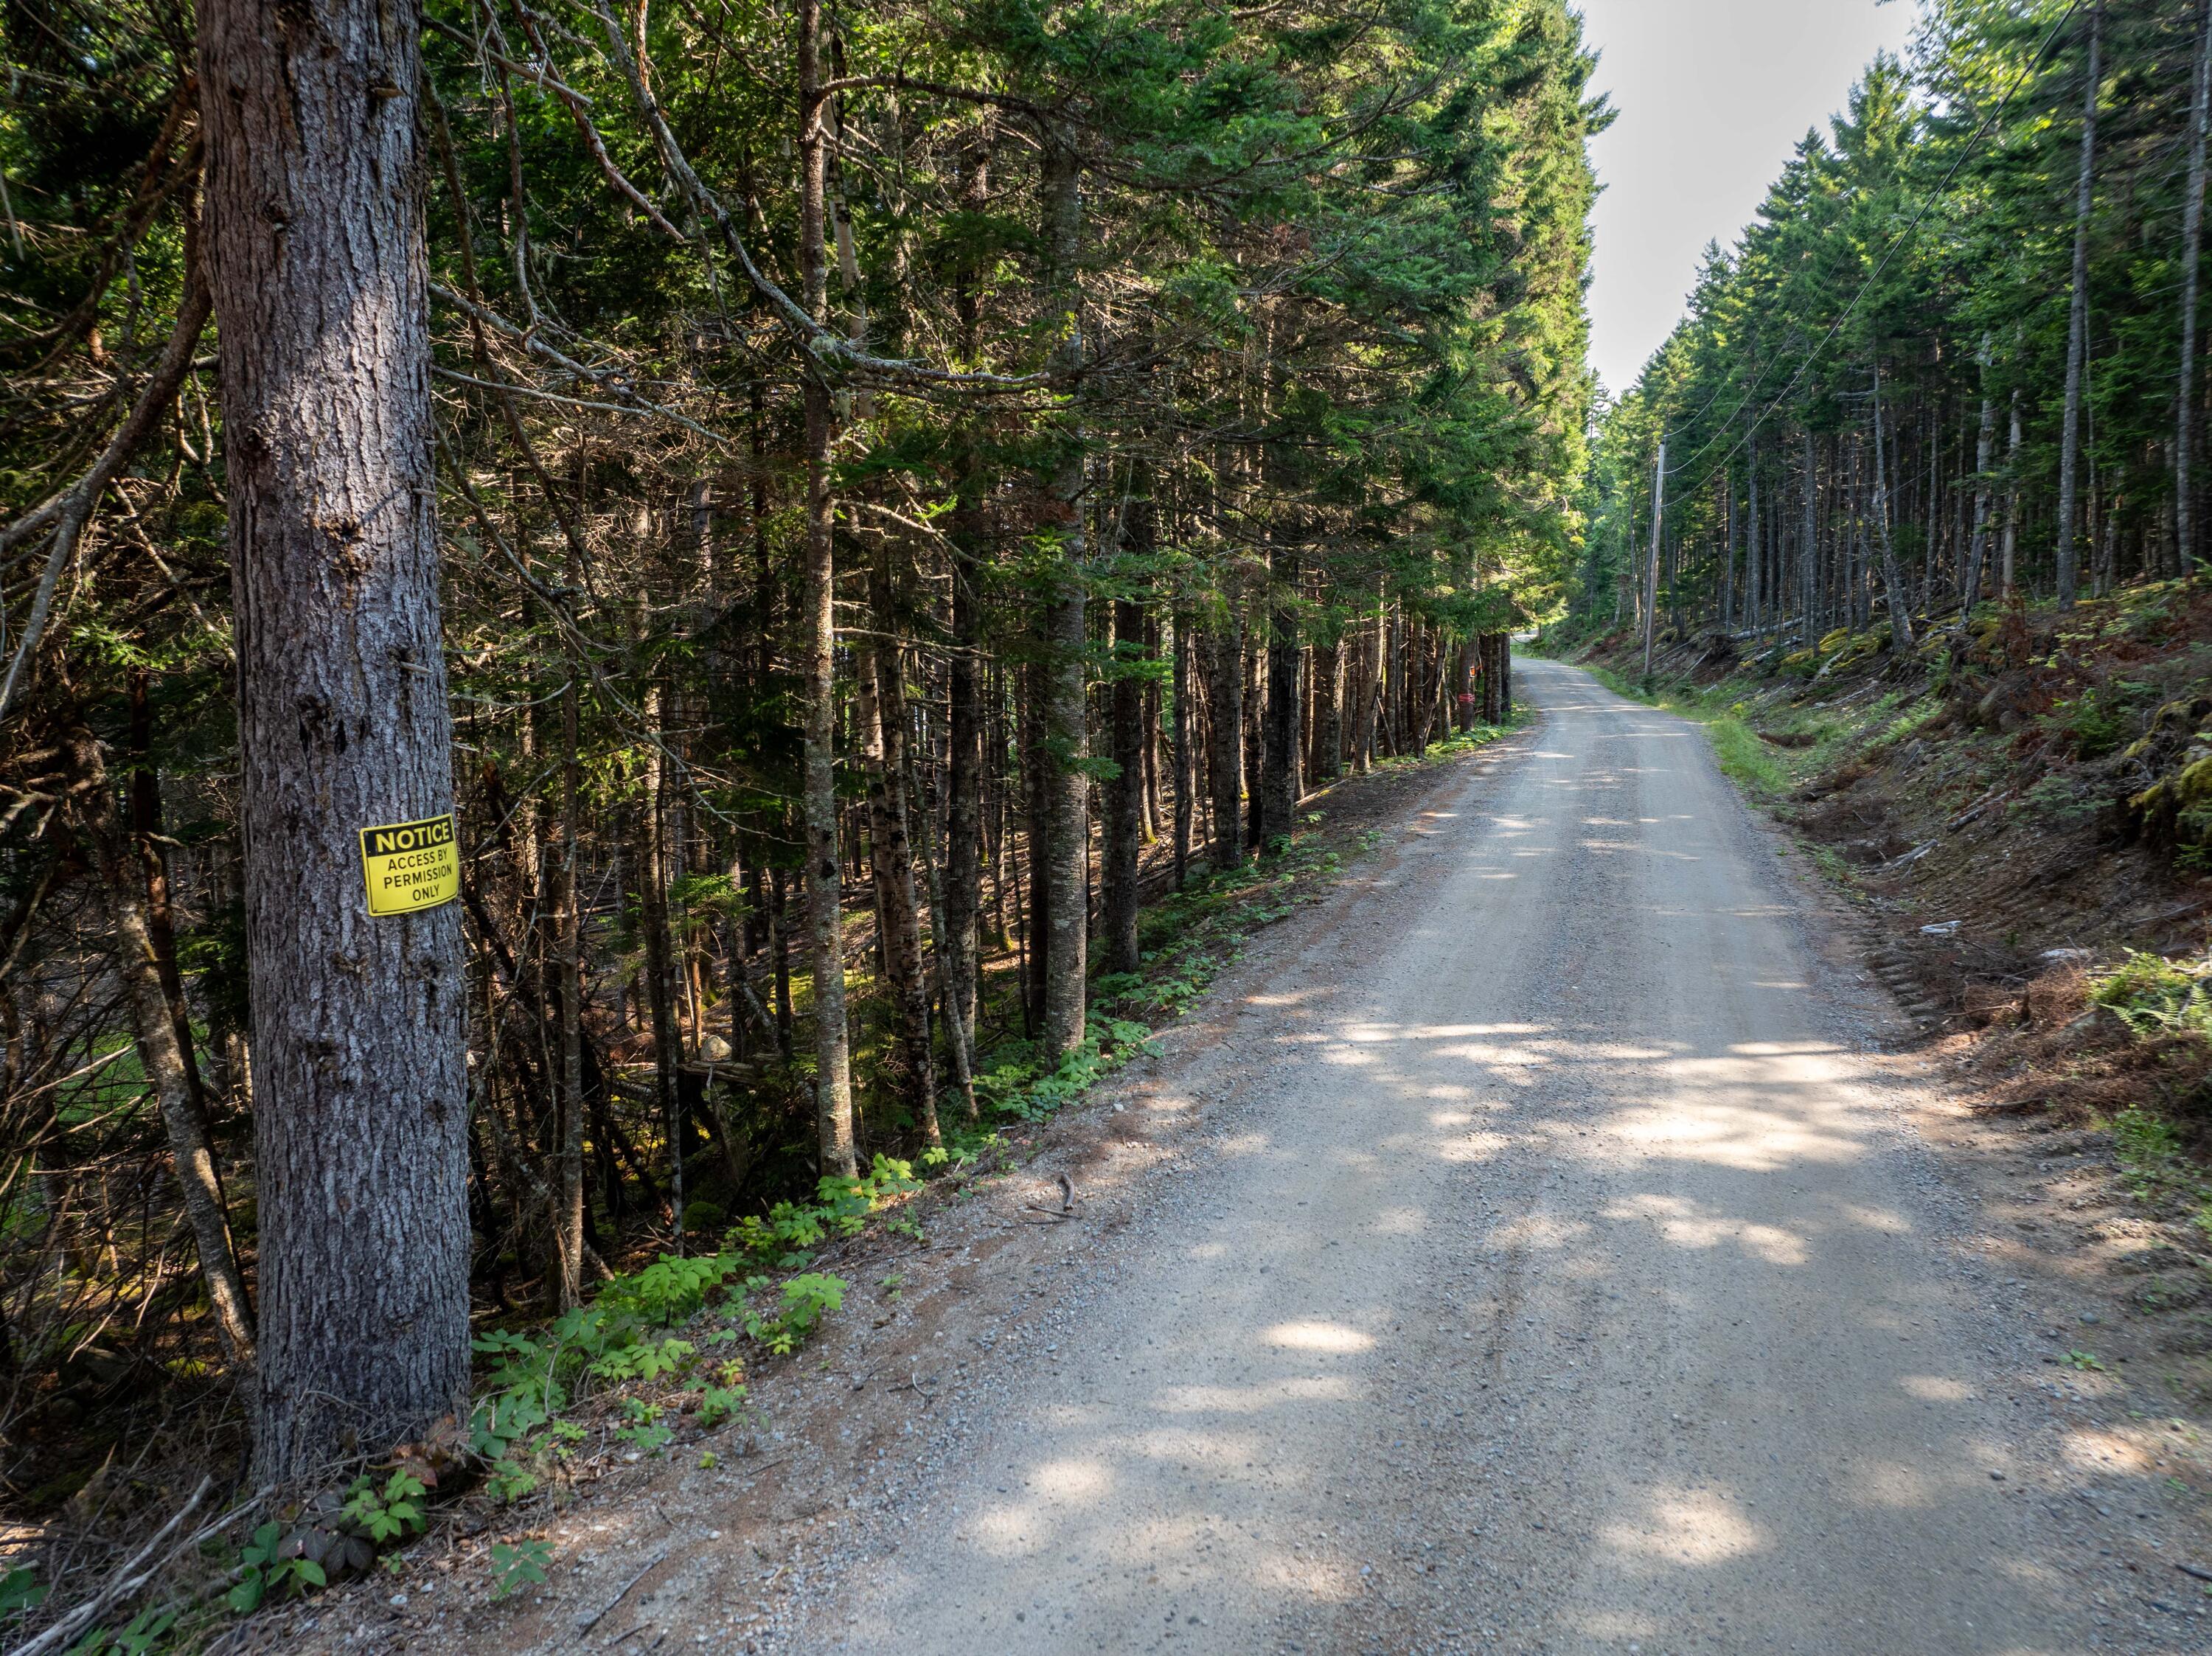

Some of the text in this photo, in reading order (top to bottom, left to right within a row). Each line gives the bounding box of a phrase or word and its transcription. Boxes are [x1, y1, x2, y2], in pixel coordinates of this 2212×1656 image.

[376, 822, 450, 852] NOTICE
[388, 848, 448, 872] ACCESS BY
[384, 863, 452, 888] PERMISSION
[413, 884, 439, 901] ONLY
